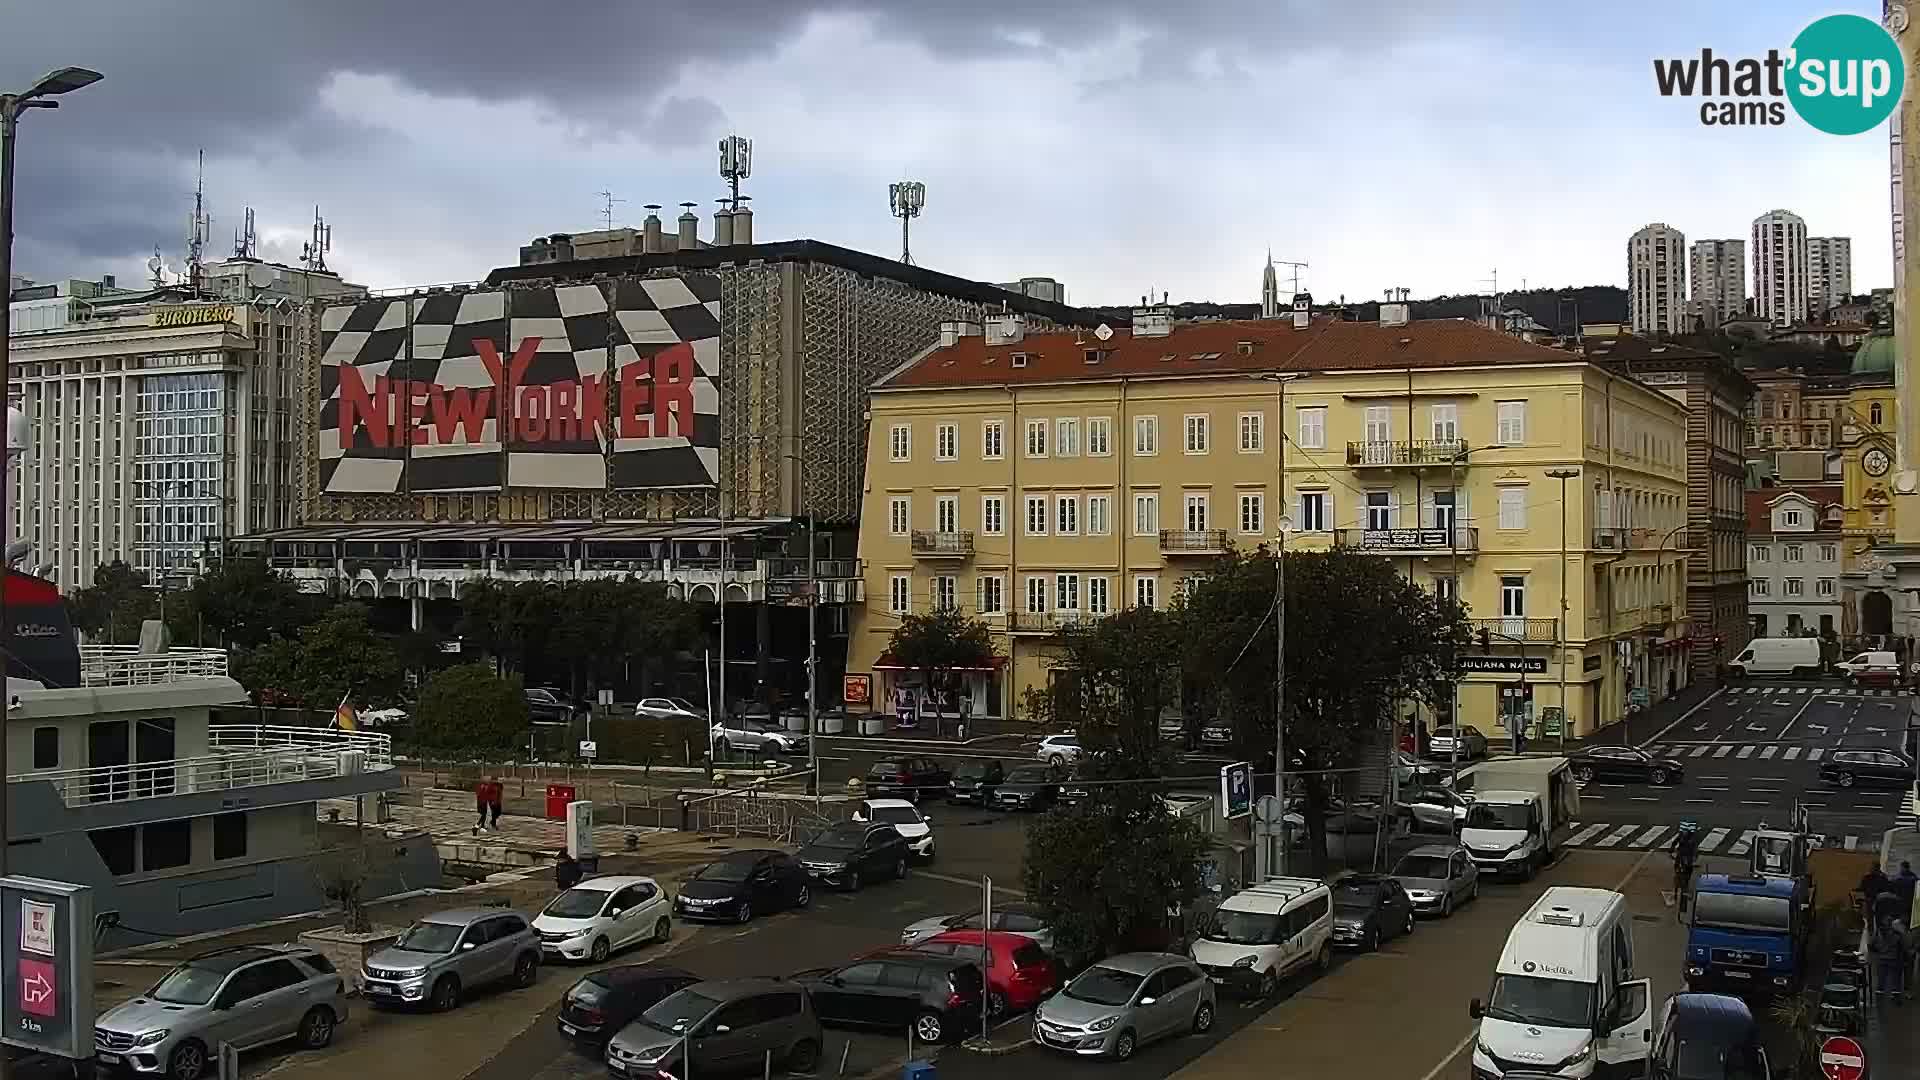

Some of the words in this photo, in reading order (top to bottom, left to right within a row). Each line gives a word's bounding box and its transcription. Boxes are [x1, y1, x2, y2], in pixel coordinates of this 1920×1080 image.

[1460, 661, 1505, 669] JULIANA
[1509, 662, 1542, 670] NAILS
[21, 1018, 28, 1030] 5
[28, 1019, 42, 1033] km
